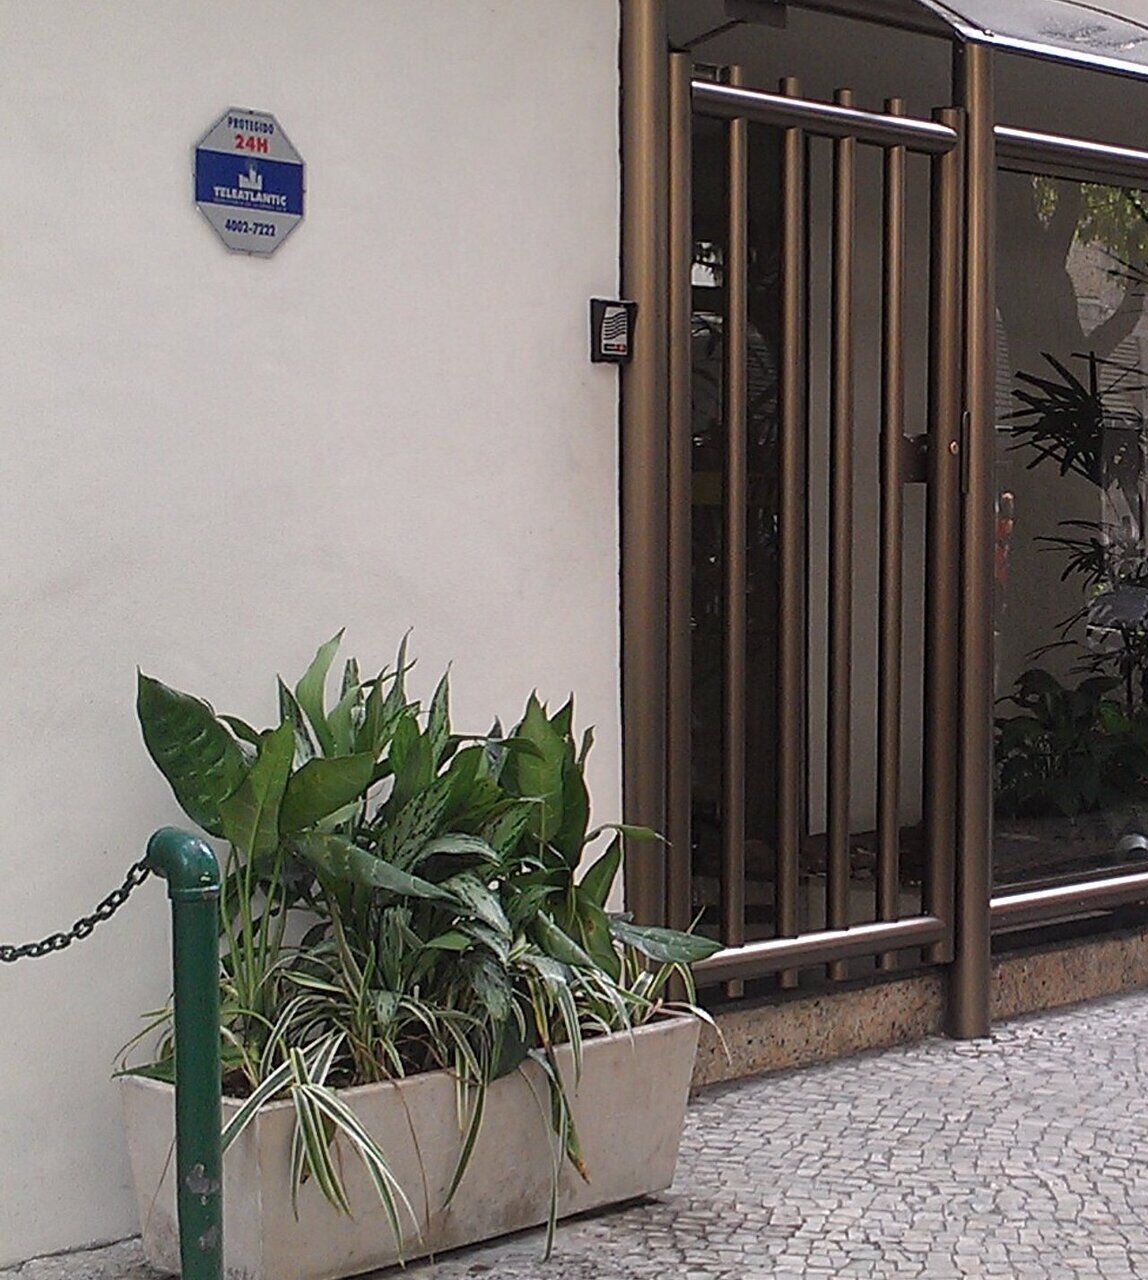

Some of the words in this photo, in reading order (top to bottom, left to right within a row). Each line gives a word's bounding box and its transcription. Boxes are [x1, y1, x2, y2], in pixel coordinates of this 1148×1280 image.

[227, 116, 275, 135] PROTEGIDO
[234, 133, 269, 154] 24H
[213, 186, 287, 207] TELEATLANTIC
